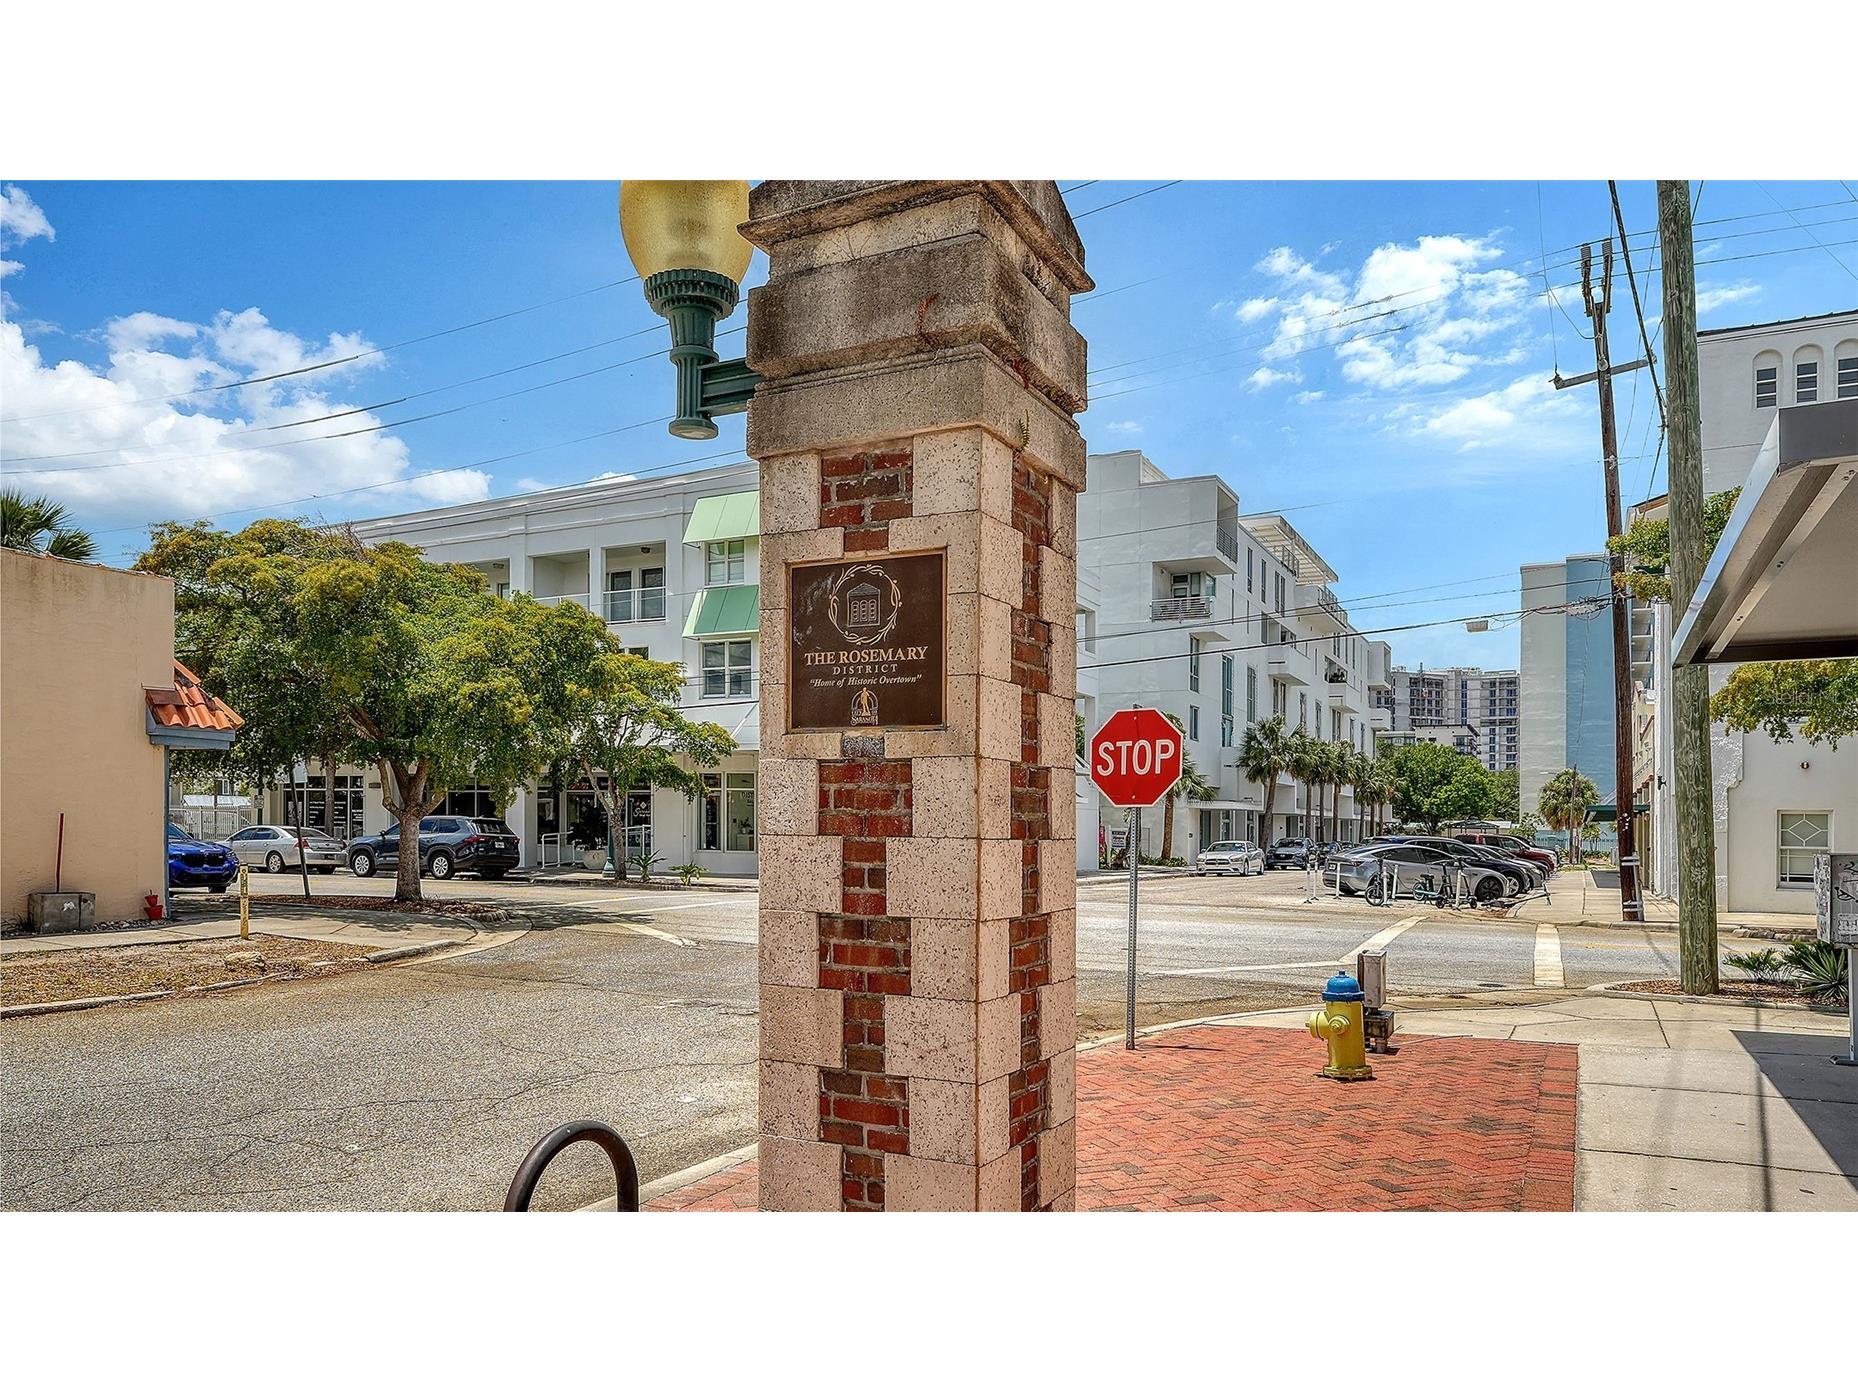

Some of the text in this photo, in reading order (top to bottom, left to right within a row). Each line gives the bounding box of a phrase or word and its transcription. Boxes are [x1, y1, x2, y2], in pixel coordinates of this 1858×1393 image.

[804, 646, 929, 665] THE ROSEMARY
[832, 663, 898, 675] DISTRICT
[836, 677, 846, 688] of
[847, 676, 877, 687] Historic
[1096, 738, 1175, 777] STOP
